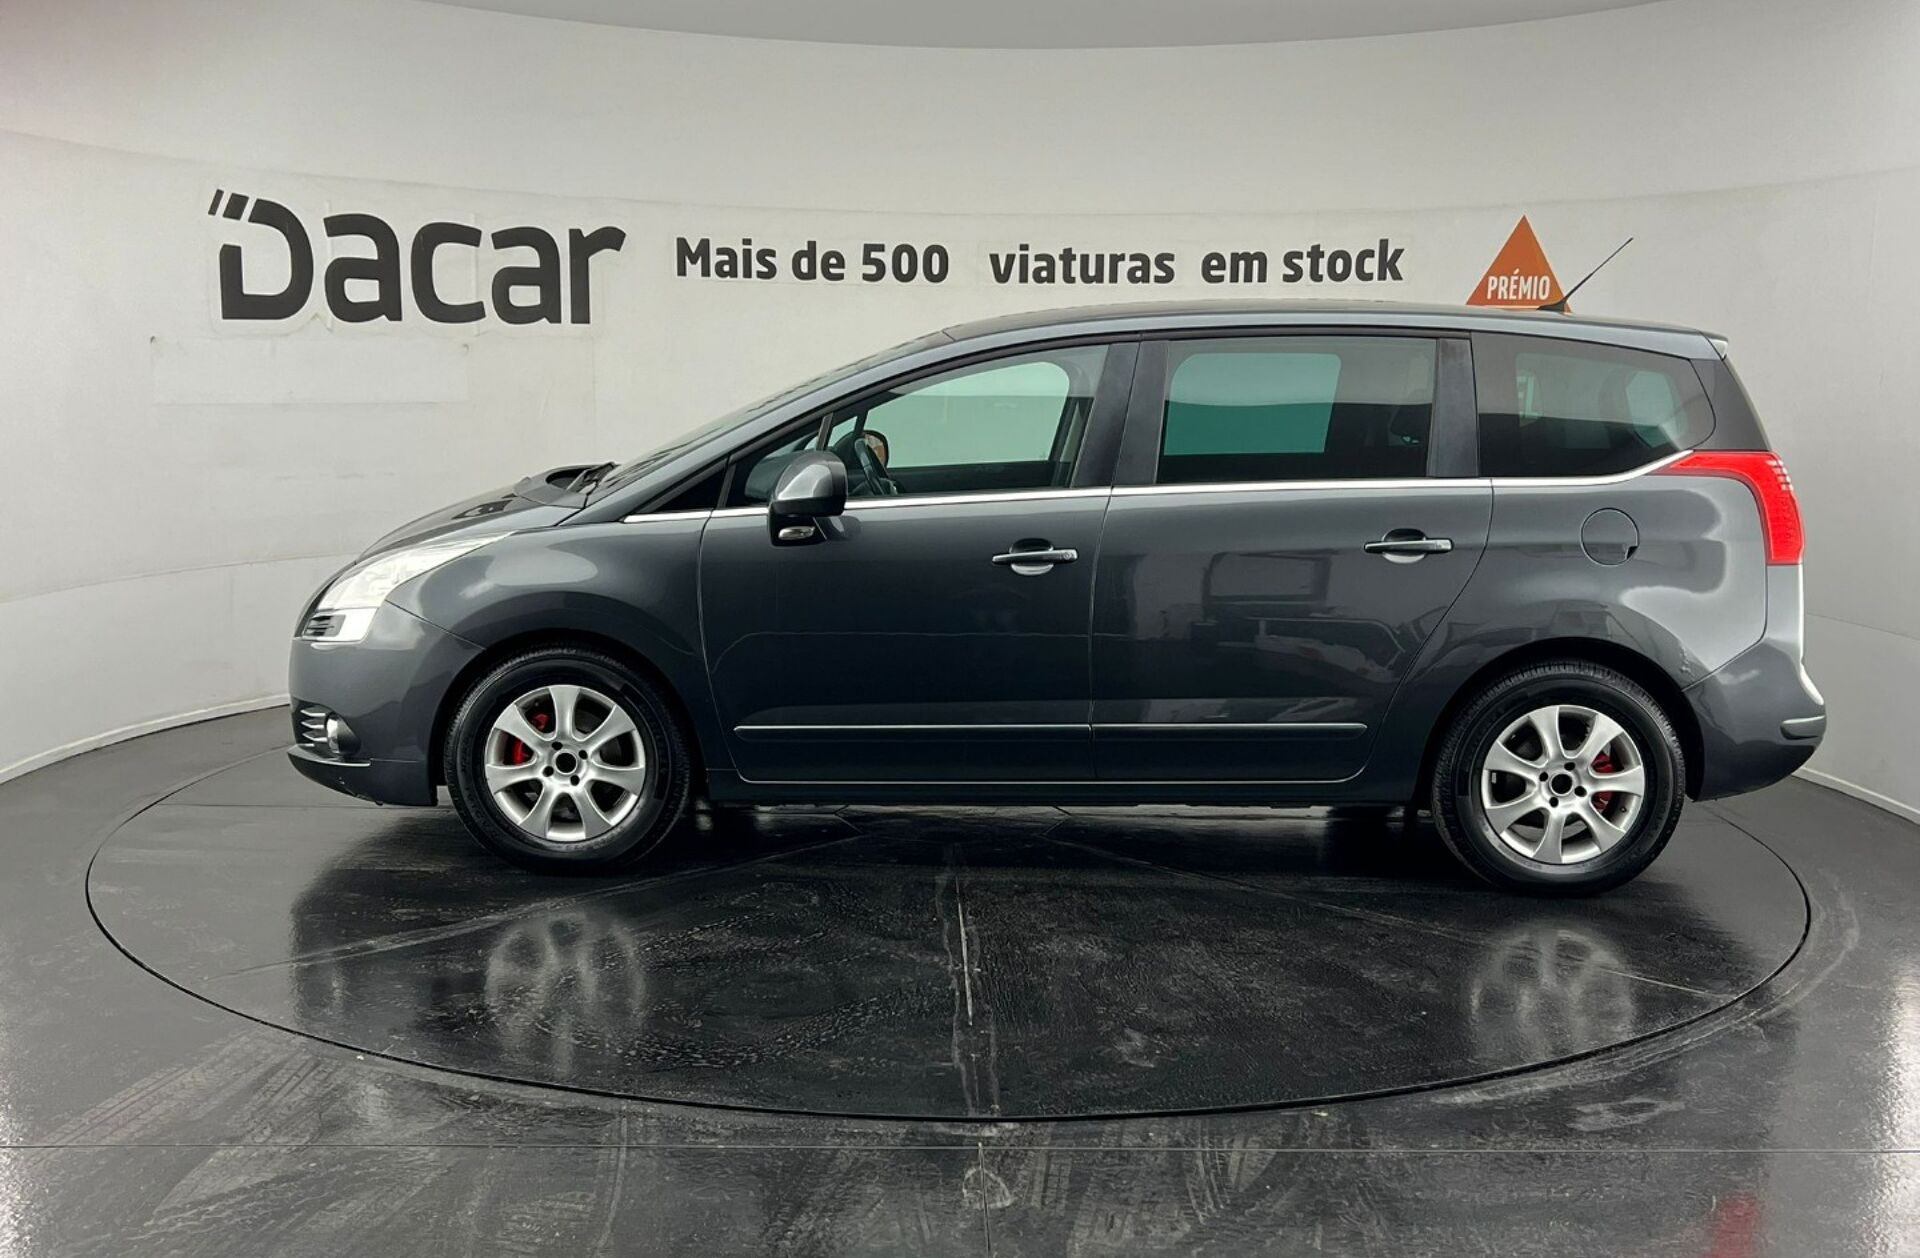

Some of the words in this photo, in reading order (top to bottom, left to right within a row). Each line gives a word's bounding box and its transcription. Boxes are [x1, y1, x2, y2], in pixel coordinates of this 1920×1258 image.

[208, 189, 626, 324] Dacar
[677, 238, 776, 279] Mais
[792, 241, 845, 281] de
[863, 244, 948, 283] 500
[990, 244, 1174, 283] viaturas
[1202, 252, 1267, 283] em
[1283, 239, 1404, 282] stock
[1487, 268, 1550, 300] PRÉMIO
